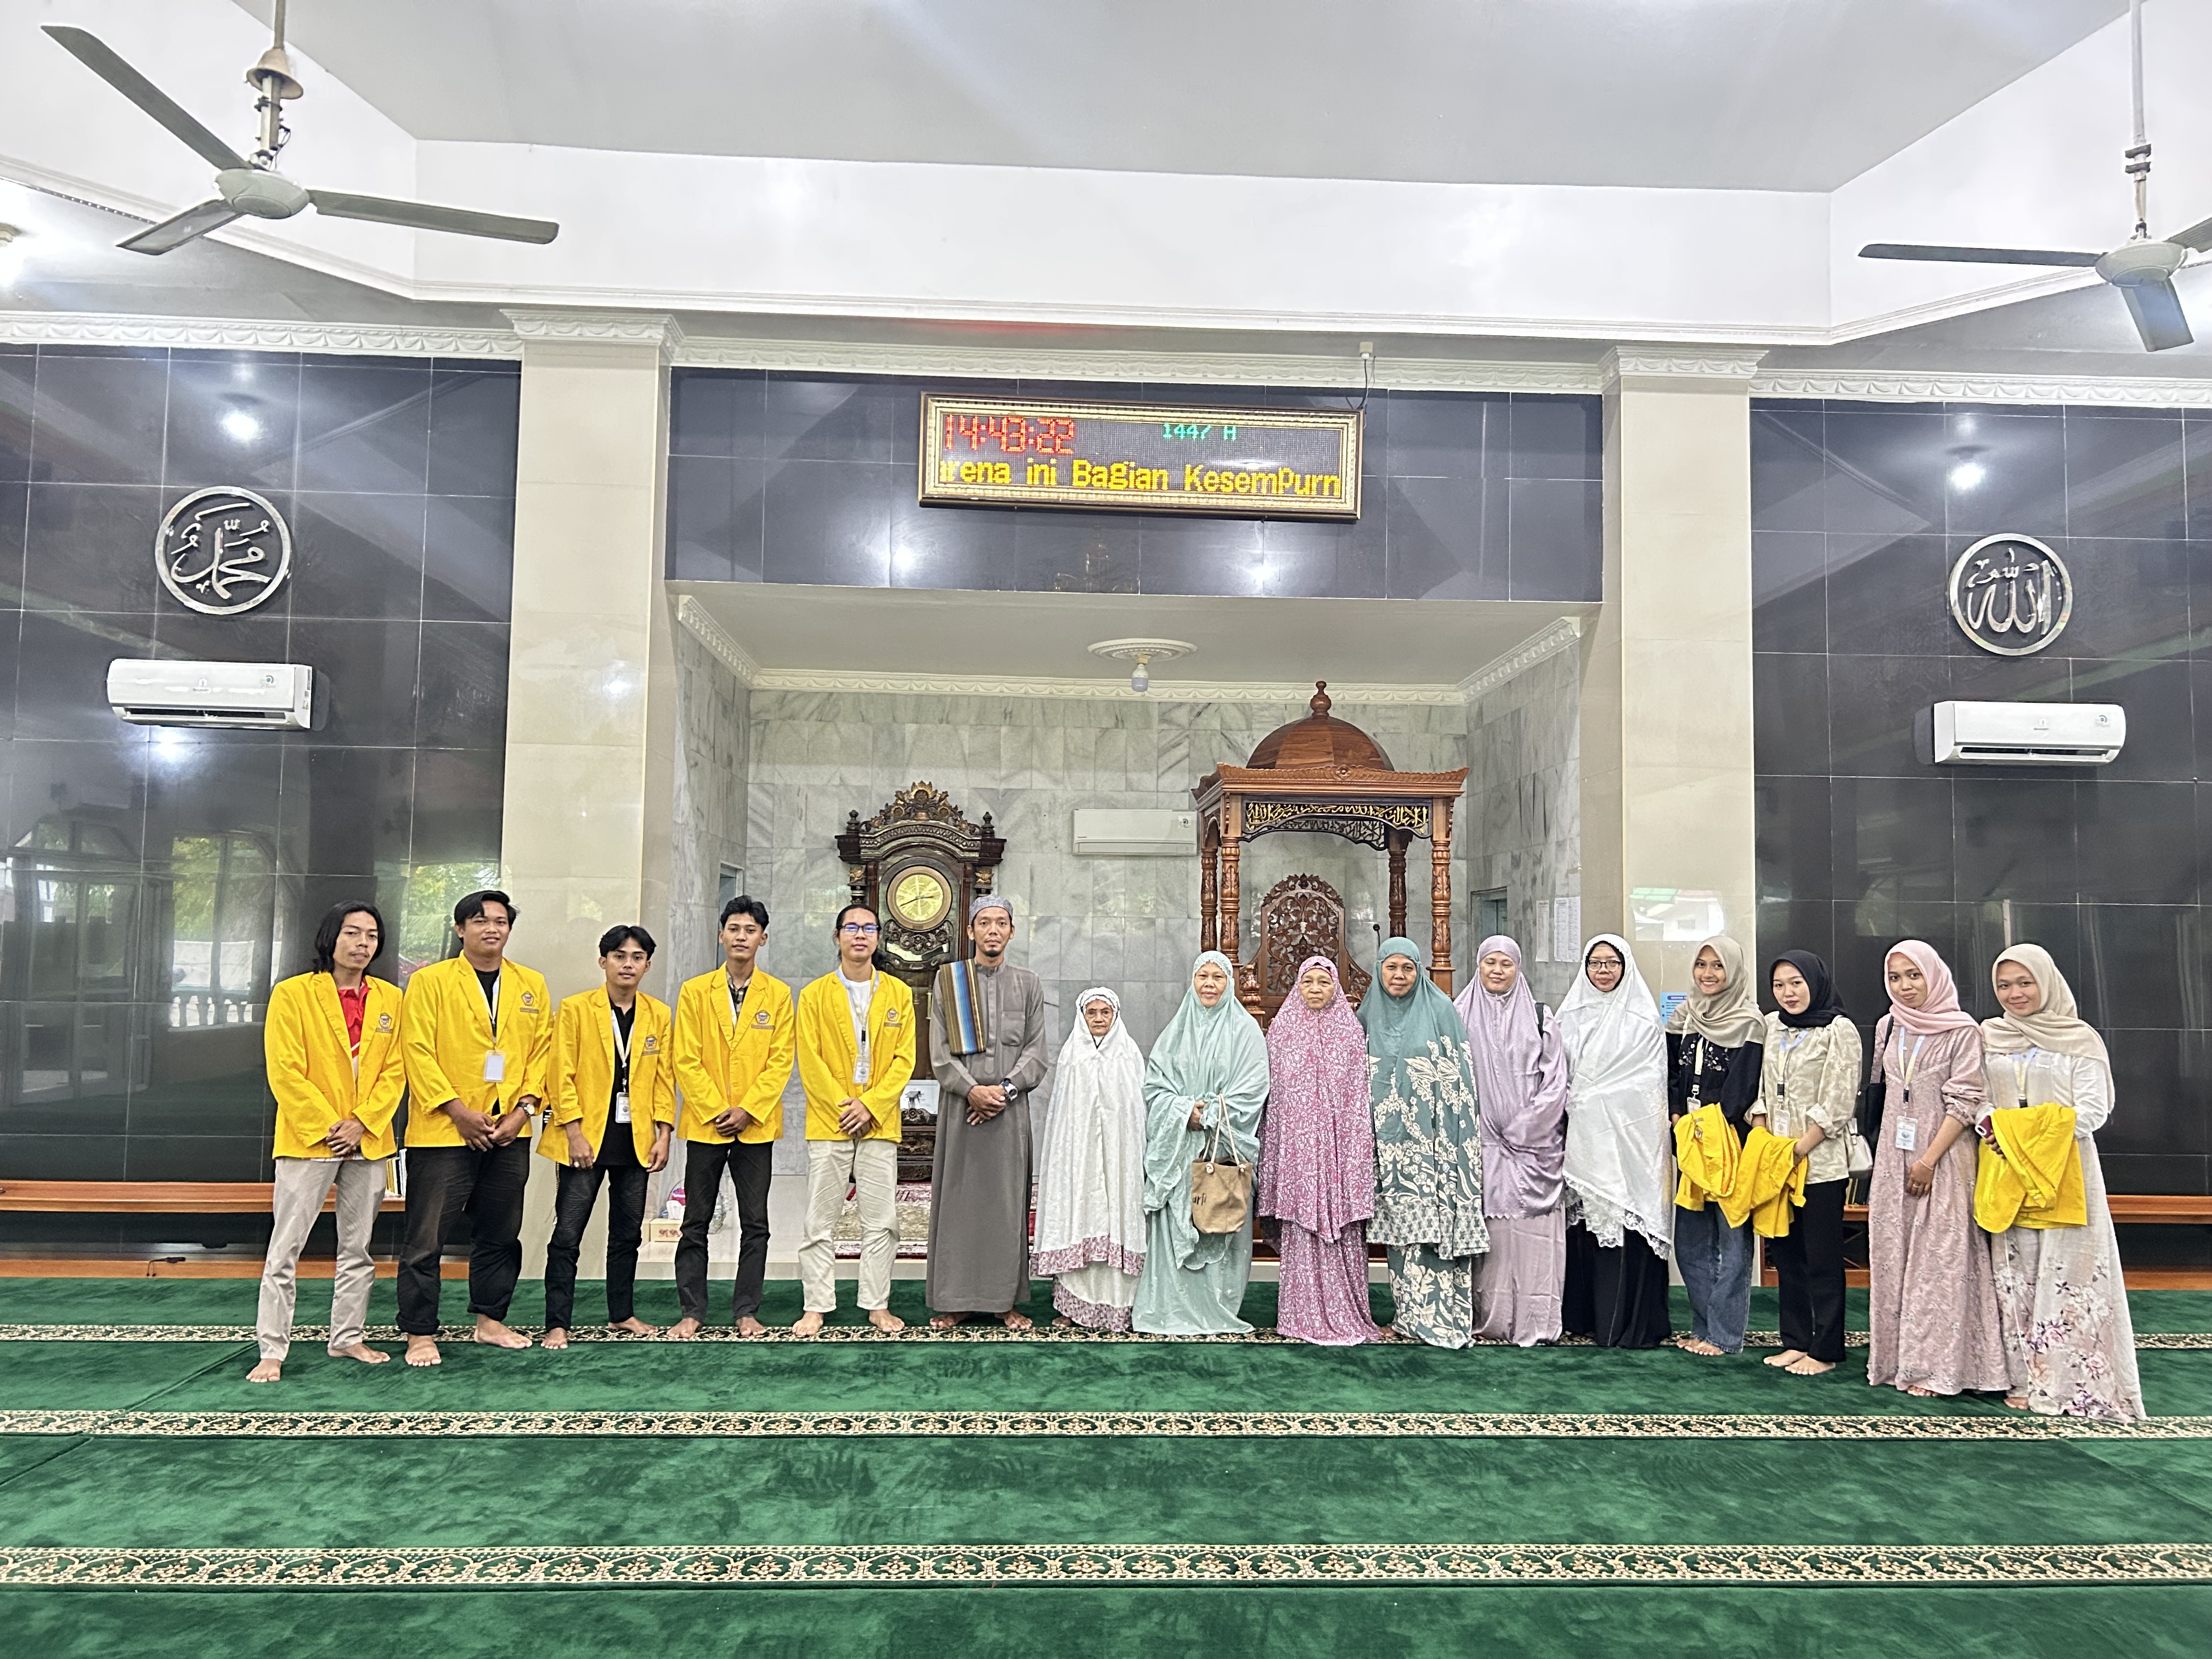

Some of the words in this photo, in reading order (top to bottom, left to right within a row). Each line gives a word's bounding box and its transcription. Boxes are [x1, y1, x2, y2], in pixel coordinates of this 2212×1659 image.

[945, 414, 1075, 455] 14:43:22
[1026, 457, 1057, 486] ini
[1073, 459, 1169, 490] Bagian
